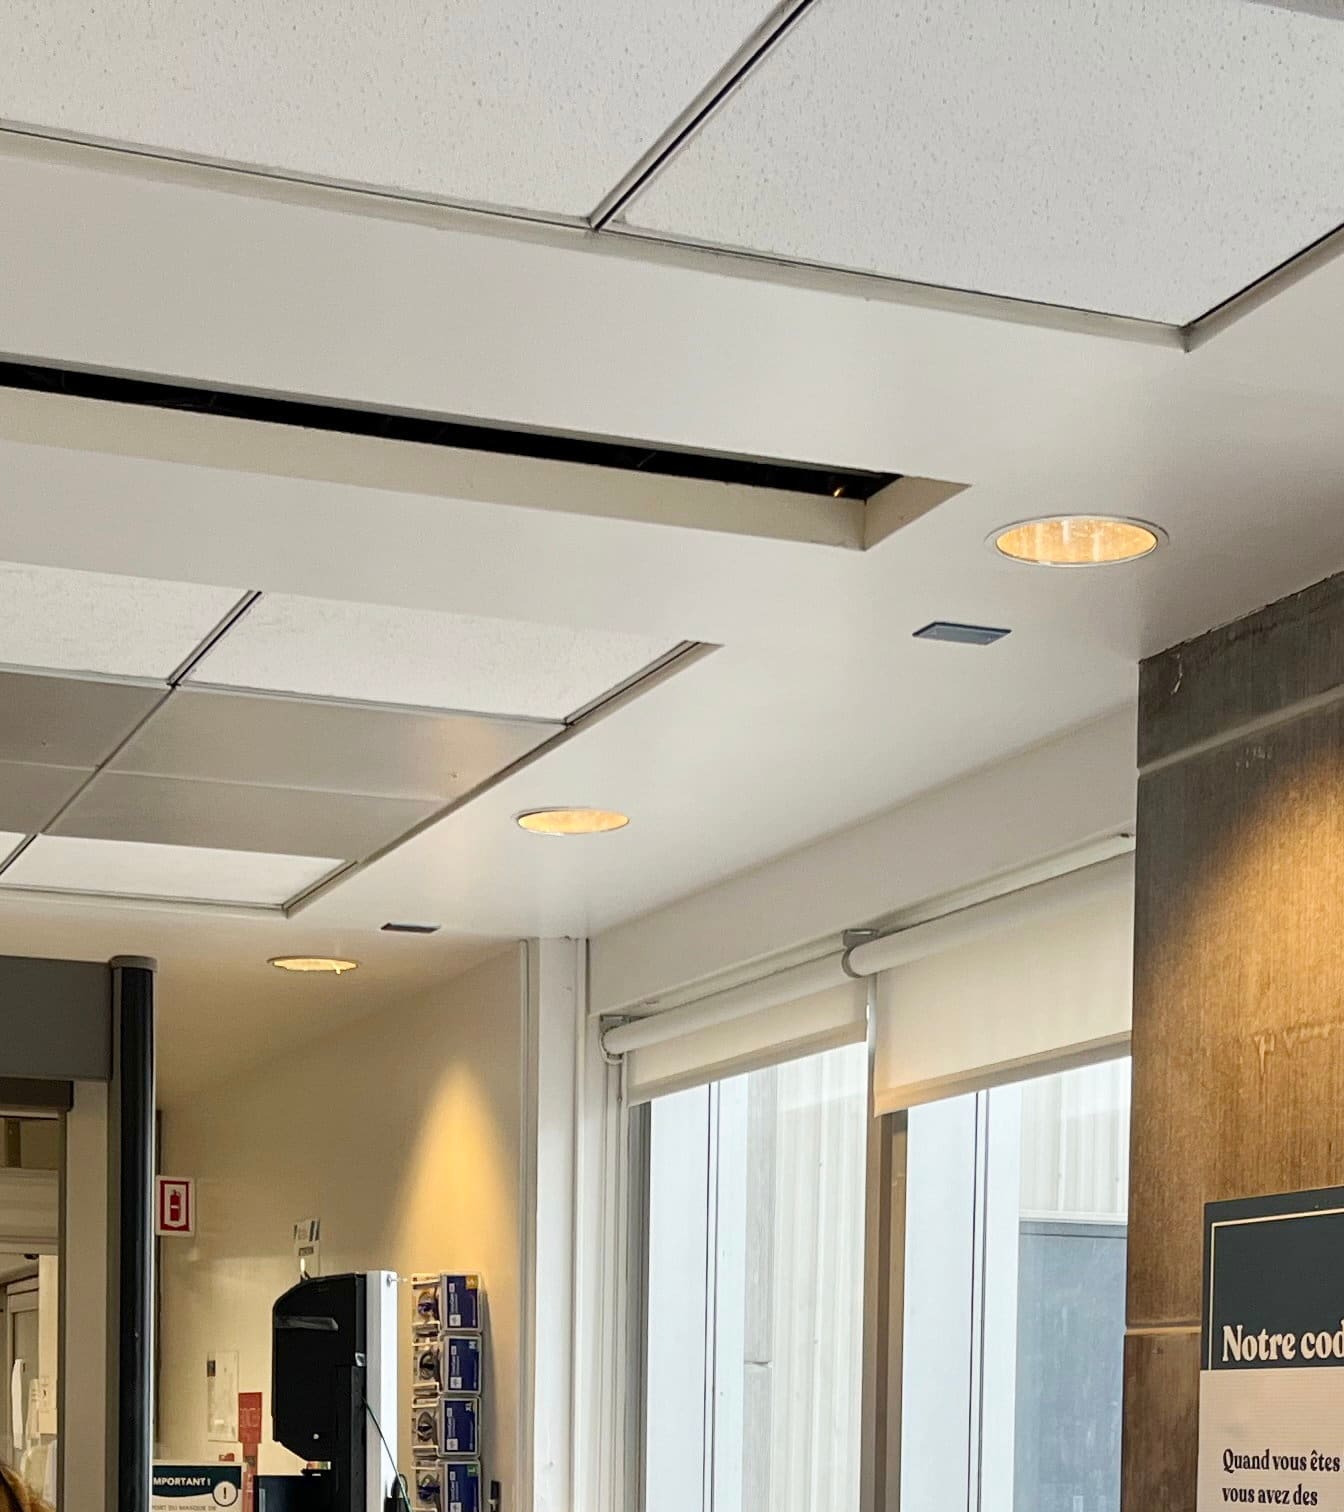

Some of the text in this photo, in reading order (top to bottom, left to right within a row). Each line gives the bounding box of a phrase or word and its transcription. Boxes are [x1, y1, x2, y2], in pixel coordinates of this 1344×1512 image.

[1222, 1324, 1297, 1363] Notre
[1222, 1448, 1270, 1474] Quand
[1272, 1454, 1307, 1472] vous
[1310, 1450, 1341, 1473] êtes
[152, 1476, 206, 1486] MPORTANT
[1221, 1483, 1319, 1507] vous avez des
